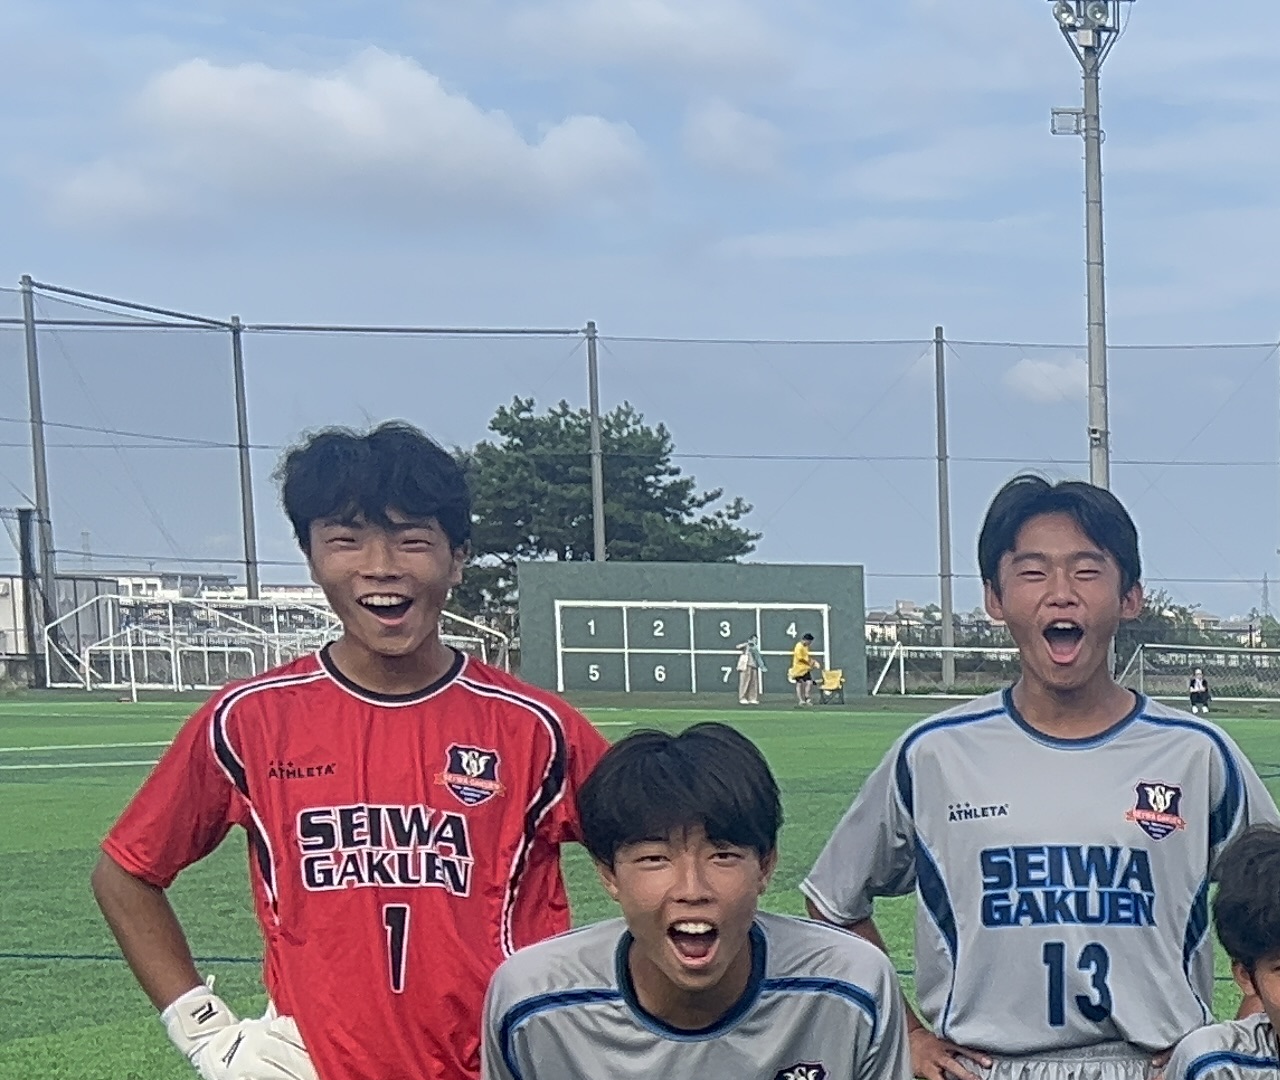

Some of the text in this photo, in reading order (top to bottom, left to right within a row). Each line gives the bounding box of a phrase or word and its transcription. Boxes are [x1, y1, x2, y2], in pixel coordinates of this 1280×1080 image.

[587, 619, 595, 635] 1
[653, 620, 664, 636] 2
[719, 621, 731, 637] 3
[786, 622, 797, 638] 4
[588, 665, 599, 681] 5
[655, 665, 666, 681] 6
[721, 666, 732, 682] 7
[269, 764, 336, 779] ATHLETA
[949, 804, 1009, 822] ATHLETA
[298, 804, 471, 858] SEIWA
[303, 851, 473, 898] GAKUEN
[980, 844, 1155, 892] SEIWA
[980, 890, 1157, 928] GAKUEN
[383, 904, 410, 994] 1
[1042, 941, 1111, 1027] 13
